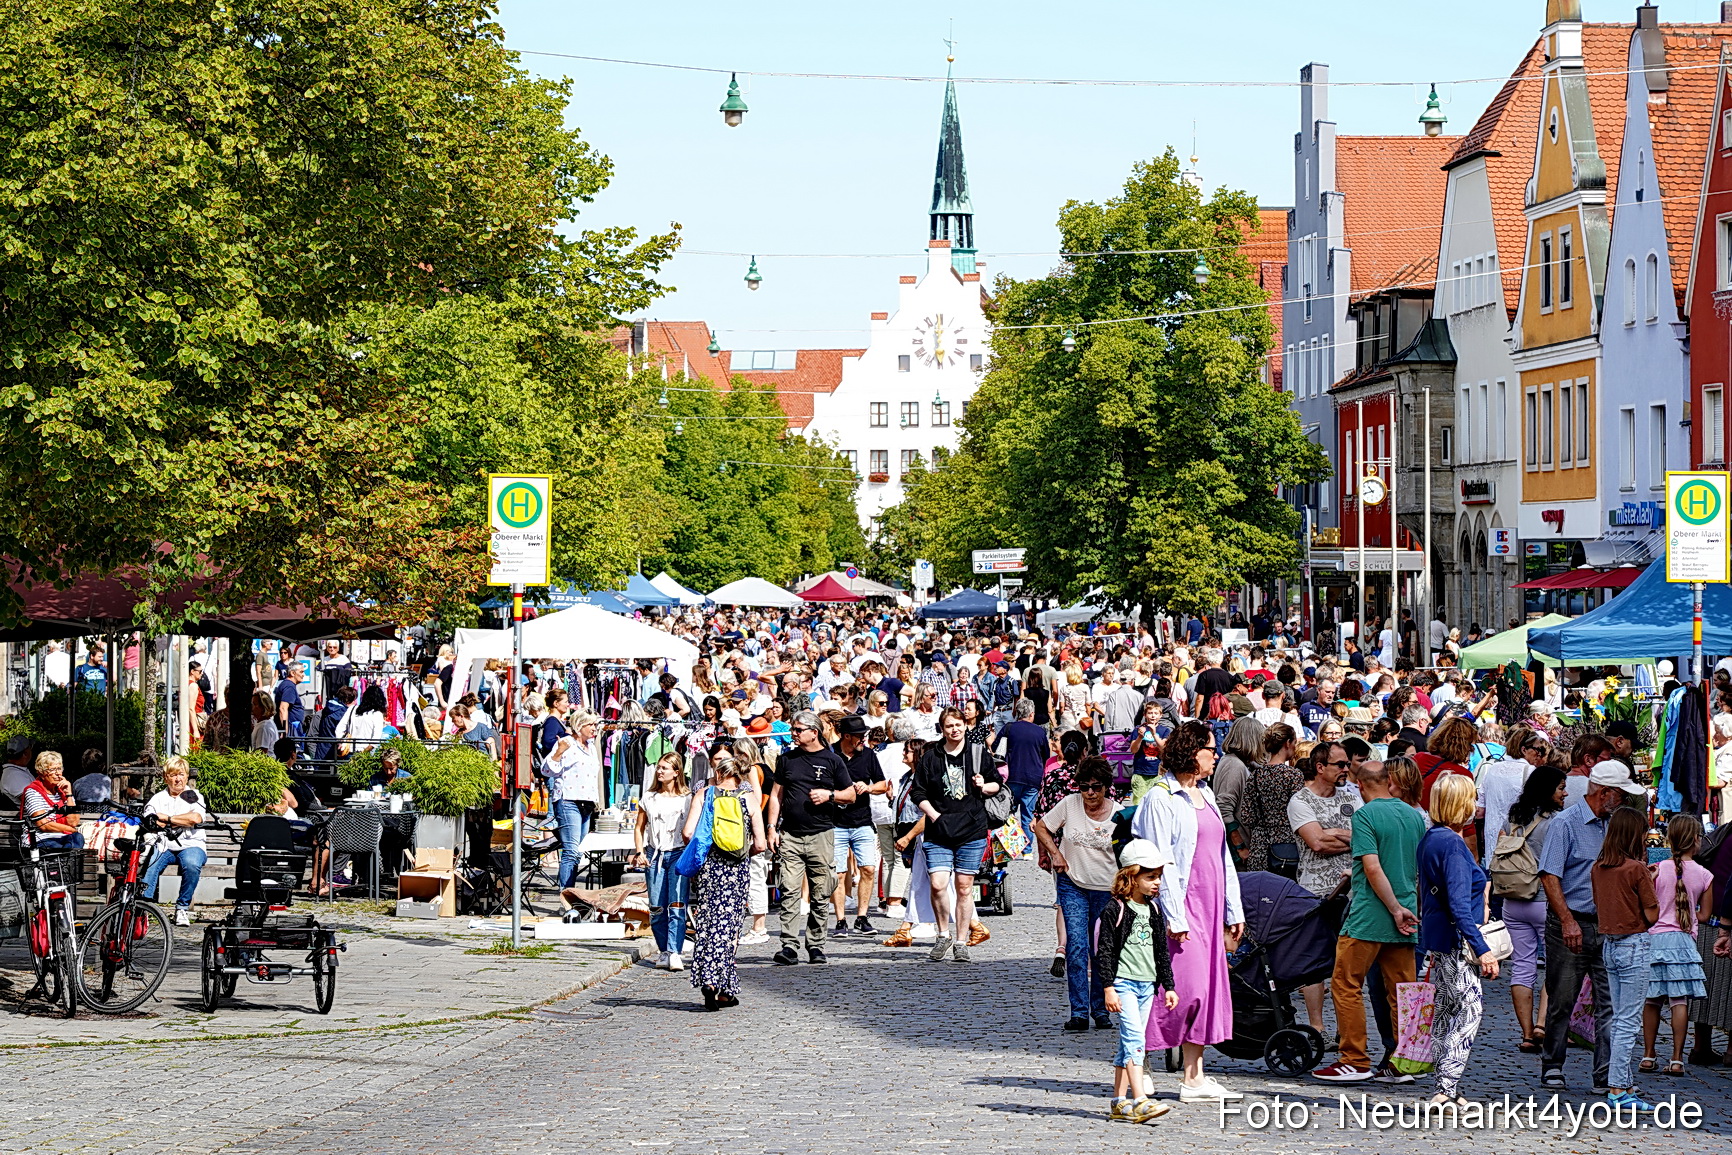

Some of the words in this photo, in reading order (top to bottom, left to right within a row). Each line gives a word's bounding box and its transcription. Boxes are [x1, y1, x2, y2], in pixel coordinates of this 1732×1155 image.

[510, 492, 529, 518] H
[1688, 489, 1708, 515] H
[495, 533, 520, 541] Oberer
[522, 533, 544, 541] Markt
[1673, 530, 1698, 538] Oberer
[1701, 530, 1722, 538] Markt
